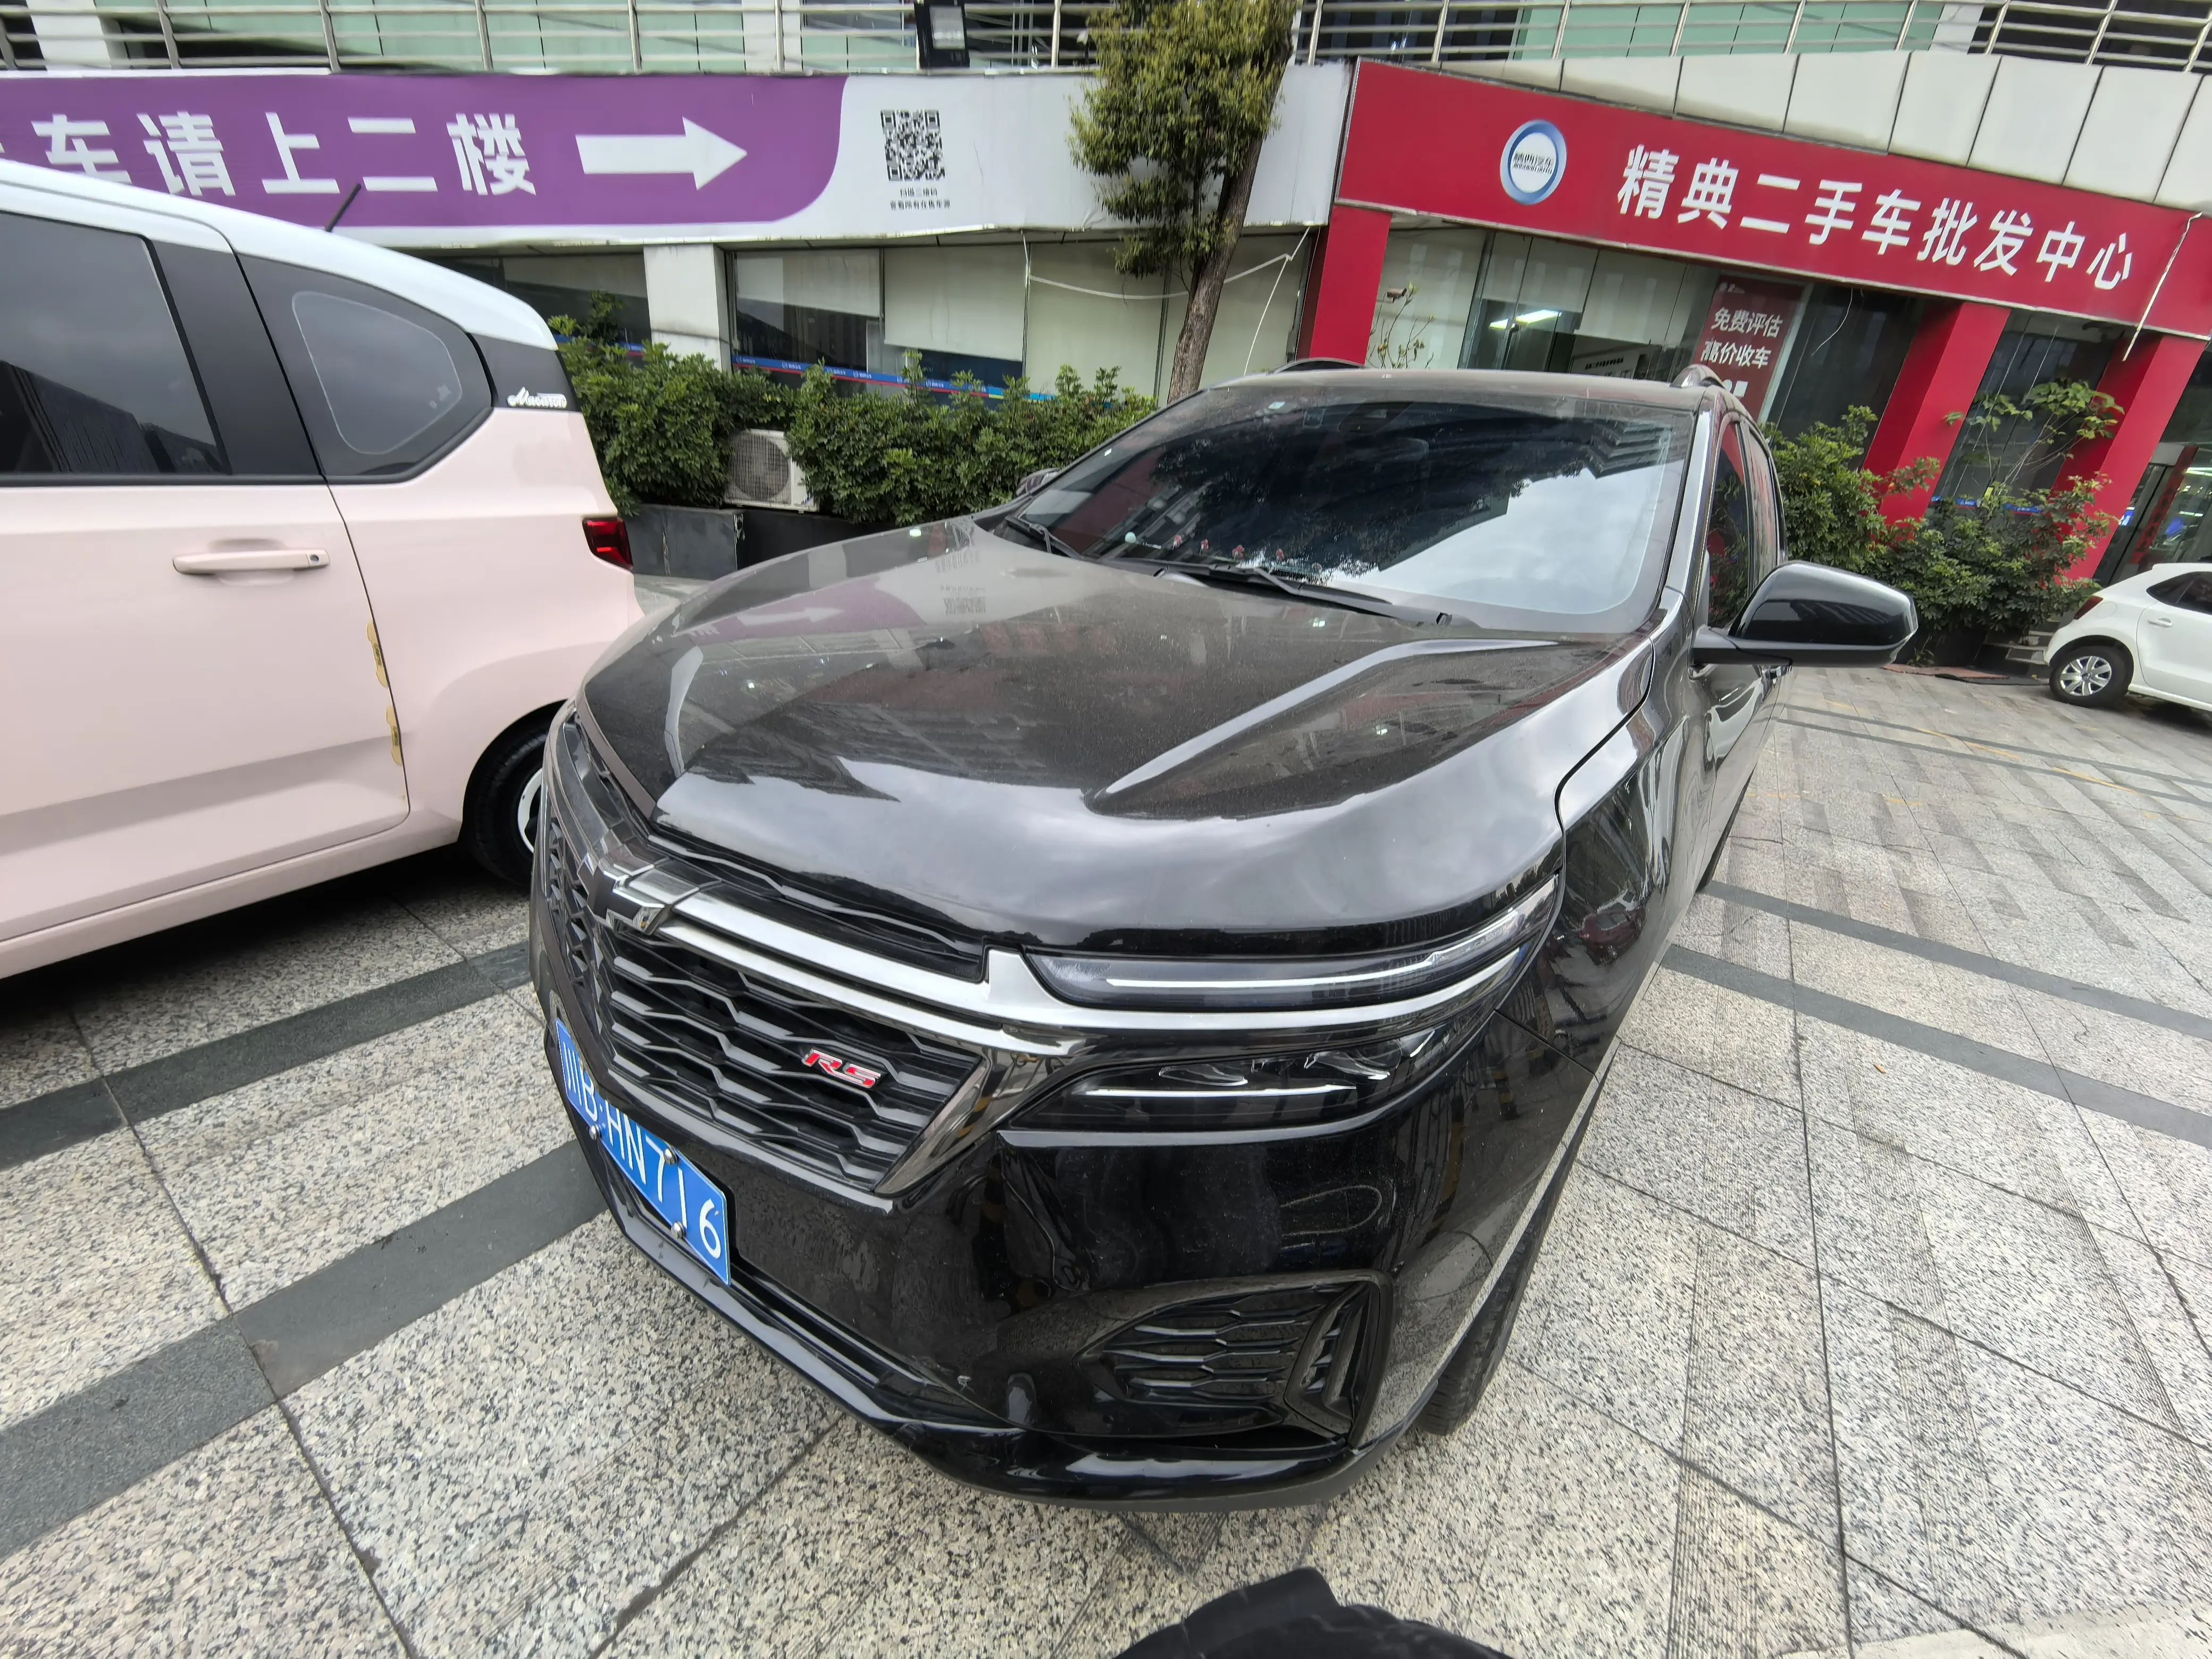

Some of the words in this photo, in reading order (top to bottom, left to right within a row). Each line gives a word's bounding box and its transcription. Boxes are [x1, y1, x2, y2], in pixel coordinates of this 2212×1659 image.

[0, 110, 535, 196] 车请上二楼
[1618, 144, 2132, 290] 精典二手车批发中心
[1711, 306, 1783, 339] 免费评估
[1700, 338, 1772, 369] 高价收车
[801, 1048, 881, 1088] RS
